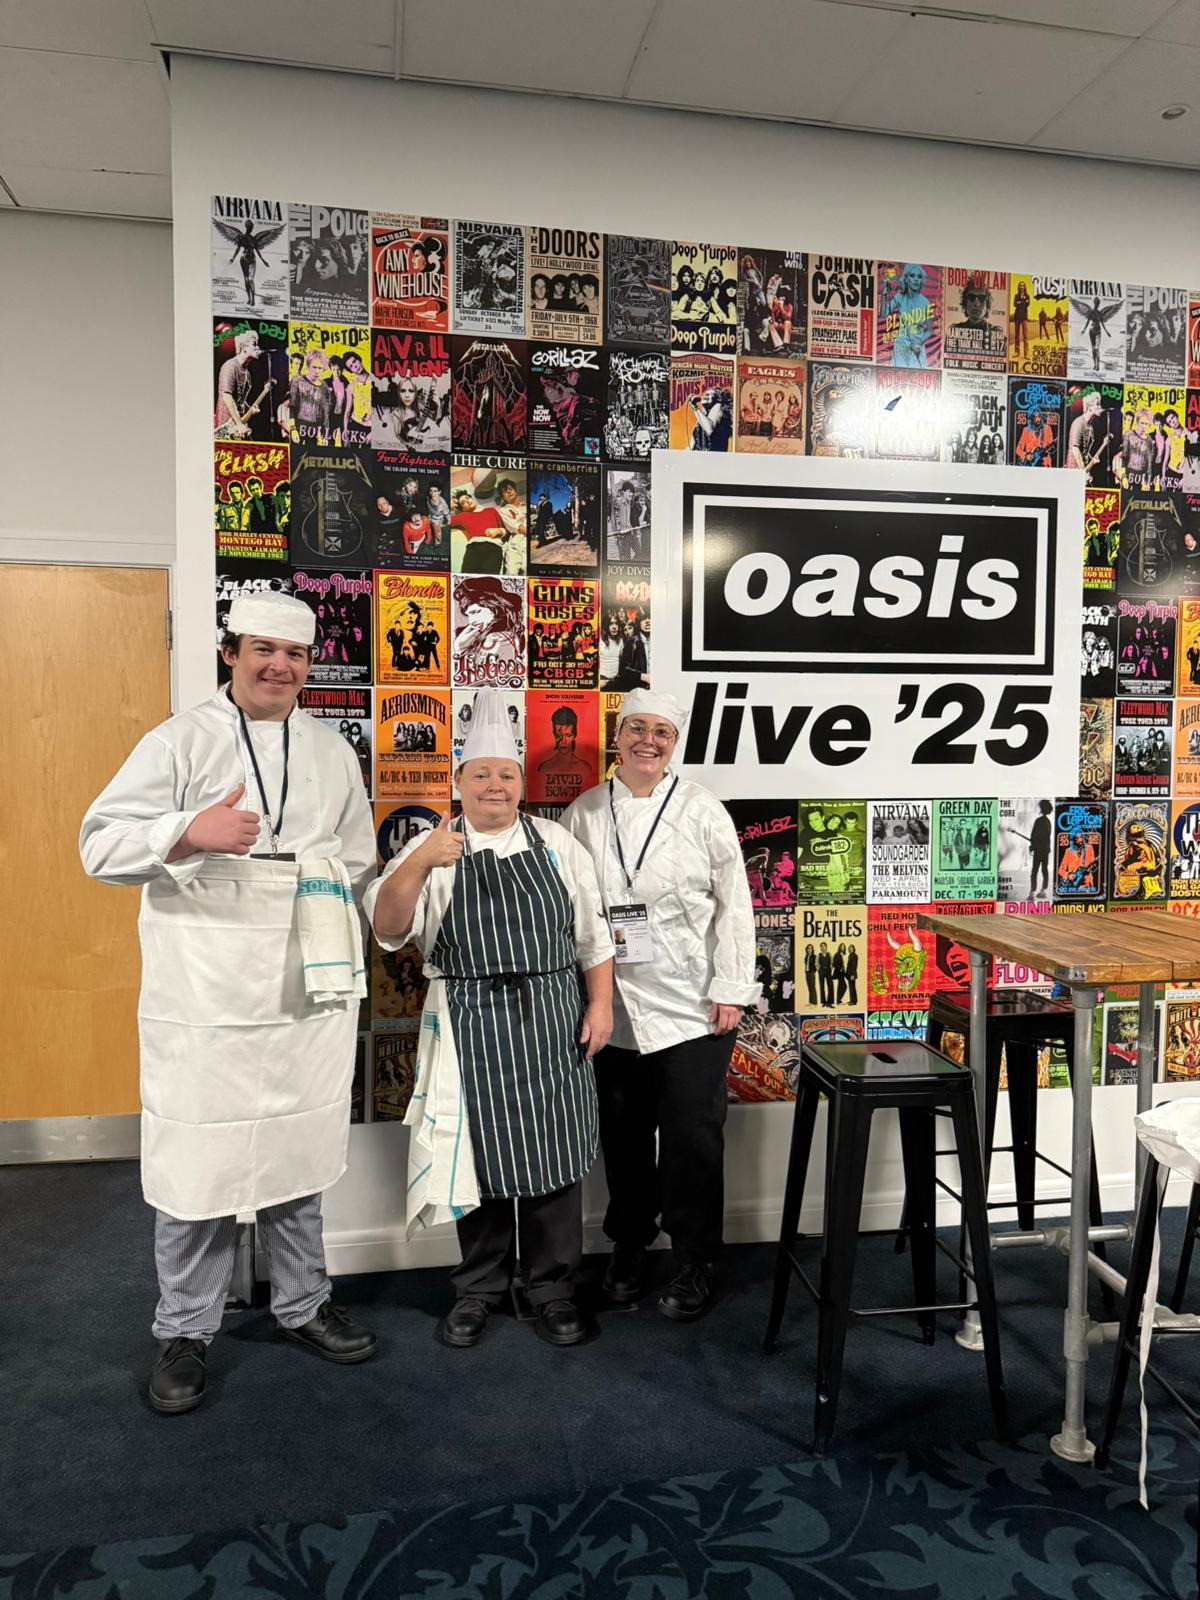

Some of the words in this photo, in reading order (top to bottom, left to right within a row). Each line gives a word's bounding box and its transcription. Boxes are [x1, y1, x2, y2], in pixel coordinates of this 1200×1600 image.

[214, 195, 283, 221] NIRVANA
[311, 205, 368, 239] POLICE
[457, 221, 523, 236] NIRVANA
[393, 230, 409, 240] BLACK
[538, 227, 600, 259] DOORS
[384, 248, 410, 271] AMY
[672, 241, 698, 263] Deep
[699, 243, 736, 264] Purple
[531, 257, 545, 267] LIVE!
[549, 259, 581, 270] HOLLYWOOD
[583, 262, 599, 271] BOWL
[815, 256, 874, 275] JOHNNY
[374, 271, 448, 300] WINEHOUSE
[948, 267, 968, 287] BOB
[973, 270, 1006, 290] DYLAN
[1032, 274, 1068, 303] RUSH
[1070, 279, 1122, 297] NIRVANA
[320, 298, 342, 306] POLICE
[1145, 287, 1186, 314] POLICE
[338, 310, 368, 319] RELEASED
[569, 315, 579, 323] 5TH
[584, 316, 597, 325] 1968
[885, 303, 935, 332] BLONDIE
[671, 326, 698, 349] Deep
[699, 327, 736, 353] Purple
[843, 330, 857, 341] PLACE
[459, 339, 521, 367] METALLICA
[748, 367, 796, 378] EAGLES
[946, 359, 959, 368] FOLK
[962, 360, 978, 369] MUSIC
[981, 361, 1005, 371] CONCERT
[672, 370, 706, 379] KOZMIC
[671, 380, 701, 412] JANIS
[702, 377, 732, 393] JOPLIN
[1026, 384, 1047, 394] ERIC
[219, 449, 285, 476] CLASH
[376, 451, 396, 463] Foo
[397, 453, 448, 467] Fighters
[452, 454, 481, 467] THE
[486, 457, 527, 470] CURE
[292, 451, 372, 488] METALLICA
[530, 461, 544, 471] the
[546, 463, 598, 474] cranberries
[1121, 496, 1182, 526] METALLICA
[219, 537, 263, 546] MONTEGO
[265, 539, 282, 547] BAY
[607, 565, 624, 576] JOY
[724, 535, 1020, 621] oasis
[223, 579, 272, 591] BLACK
[293, 572, 330, 600] Deep
[330, 573, 372, 601] Purple
[382, 577, 445, 600] Blondie
[534, 585, 594, 605] GUNS
[534, 606, 594, 621] ROSES
[1118, 599, 1145, 623] Deep
[1145, 600, 1177, 624] Purple
[544, 668, 584, 678] CBGB
[302, 689, 346, 705] FLEETWOOD
[348, 690, 365, 705] MAC
[325, 709, 344, 717] TOUR
[380, 693, 447, 726] AEROSMITH
[1120, 702, 1154, 716] FLEETWOOD
[1155, 702, 1168, 715] MAC
[682, 682, 872, 766] live
[894, 682, 1052, 766] '25
[424, 754, 449, 762] TOUR
[380, 771, 400, 783] AC/DC
[402, 770, 407, 783] &
[408, 771, 421, 783] TED
[423, 771, 448, 783] NUGENT
[546, 774, 582, 785] DAVID
[546, 786, 582, 797] BOWIE
[874, 805, 929, 820] NIRVANA
[939, 802, 972, 814] GREEN
[974, 801, 992, 814] DAY
[1000, 809, 1015, 817] CURE
[1069, 806, 1089, 815] ERIC
[1060, 812, 1103, 830] CLAPTON
[872, 846, 928, 861] SOUNDGARDEN
[873, 865, 889, 876] THE
[892, 865, 928, 876] MELVINS
[935, 877, 955, 885] MADISON
[957, 876, 975, 885] SQUARE
[977, 876, 995, 885] GARDEN
[935, 891, 954, 899] DEC.
[958, 891, 966, 899] 17
[974, 891, 994, 899] 1994
[803, 911, 862, 942] BEATLES
[732, 1049, 760, 1079] FALL
[764, 1076, 782, 1094] OUT
